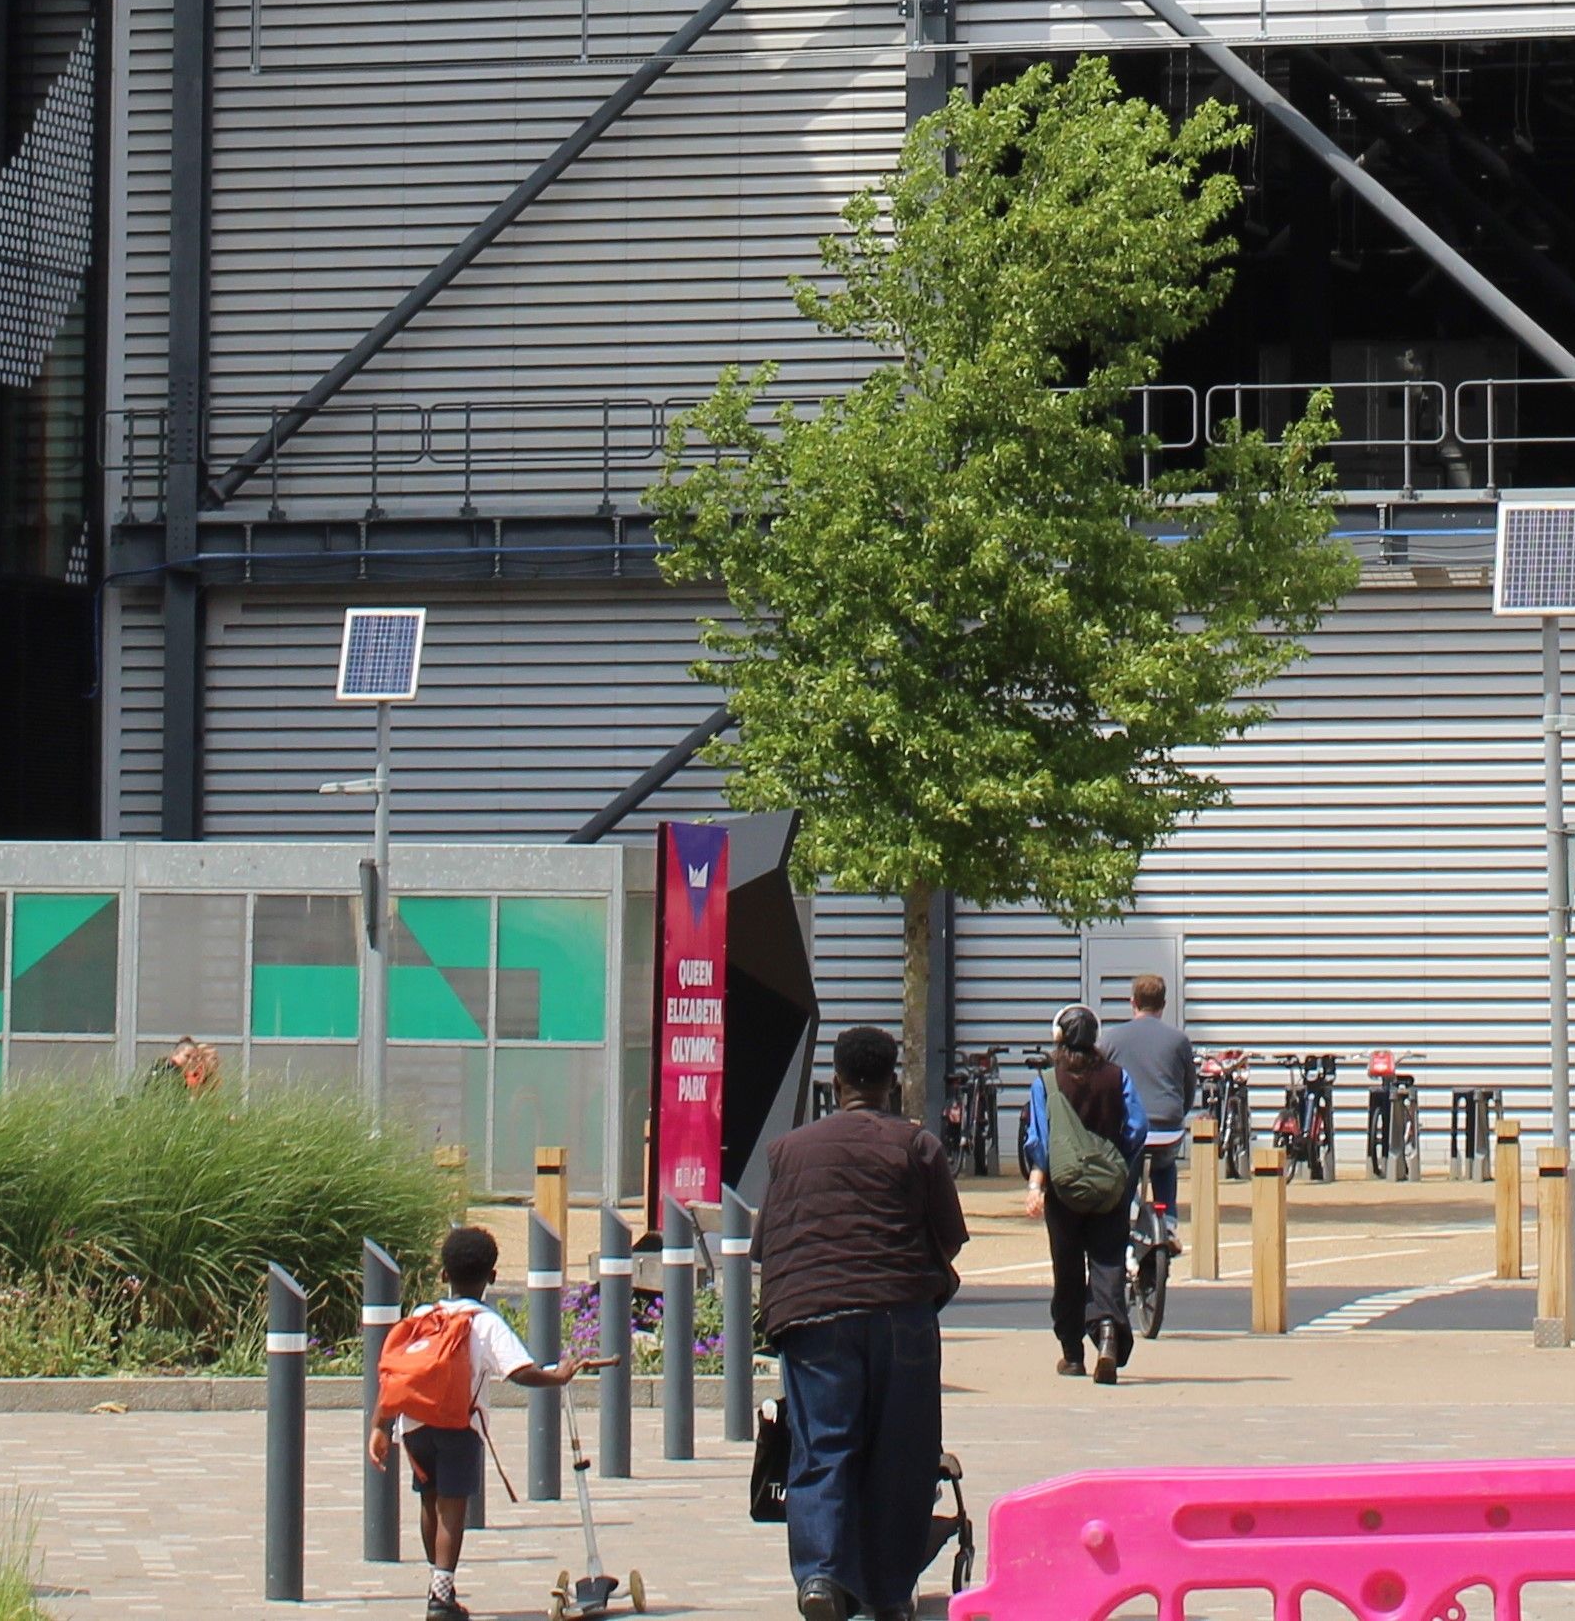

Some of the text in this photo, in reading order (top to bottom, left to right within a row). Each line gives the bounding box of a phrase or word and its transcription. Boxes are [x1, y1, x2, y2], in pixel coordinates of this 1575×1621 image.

[678, 959, 713, 989] QUEEN
[666, 997, 722, 1024] ELIZABETH
[671, 1036, 716, 1063] OLYMPIC
[678, 1075, 707, 1101] PARK
[769, 1482, 787, 1501] Tu
